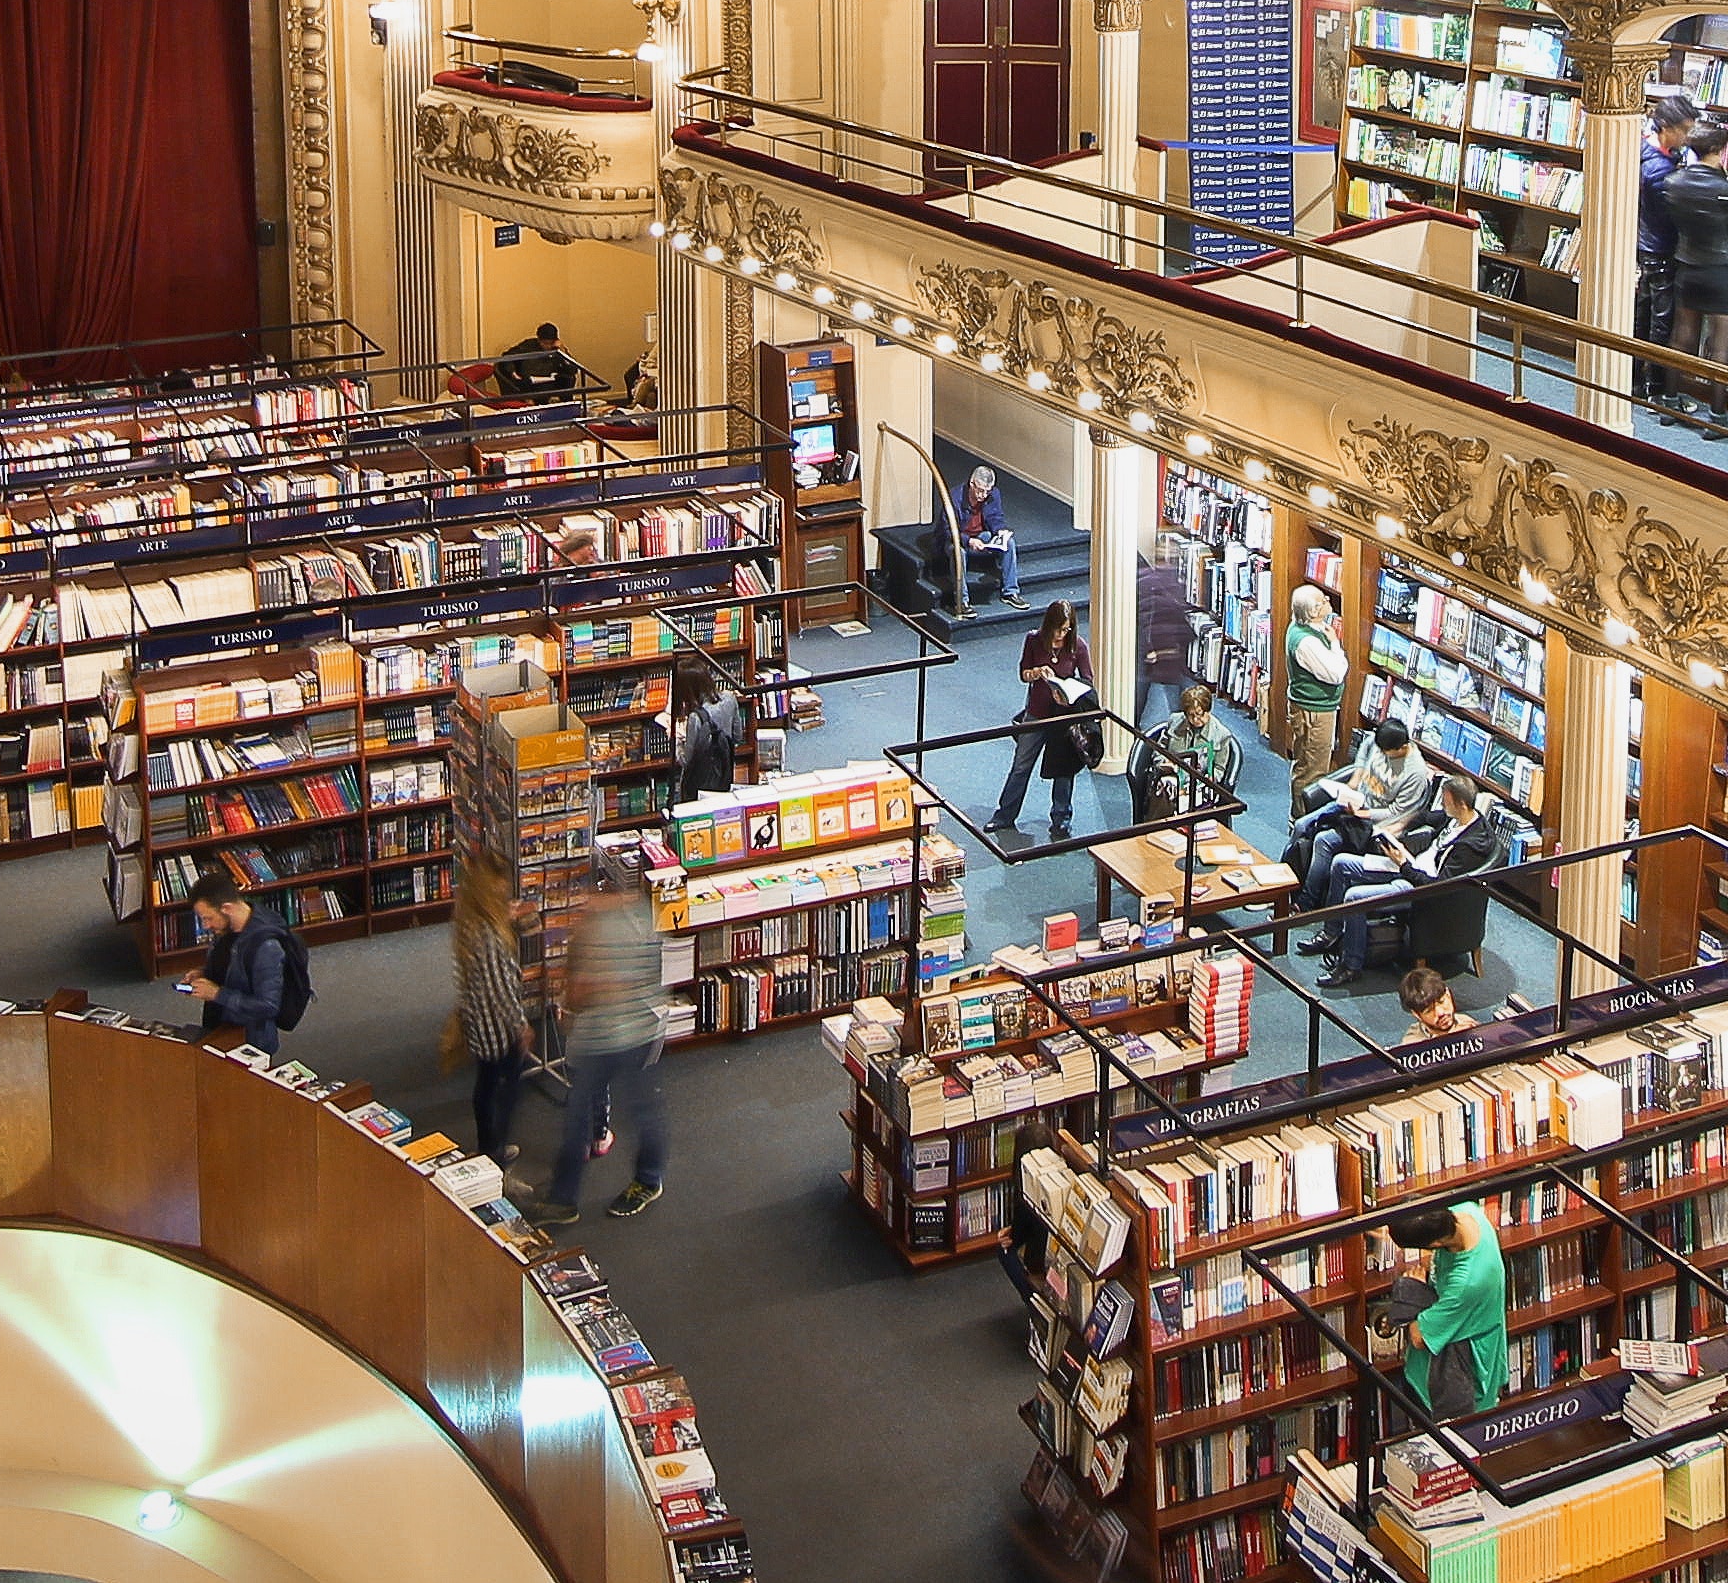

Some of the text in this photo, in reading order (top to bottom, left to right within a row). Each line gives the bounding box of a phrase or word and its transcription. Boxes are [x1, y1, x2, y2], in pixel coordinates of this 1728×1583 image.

[670, 475, 698, 487] ARTE
[503, 494, 533, 506] ARTE
[324, 512, 356, 526] ARTE
[136, 539, 170, 553] ARTE
[615, 576, 671, 592] TURISMO
[421, 601, 480, 618] TURISMO
[210, 628, 273, 646] TURISMO
[1609, 977, 1696, 1014] BIOGRFÍAS
[1483, 1397, 1581, 1444] DERECHO
